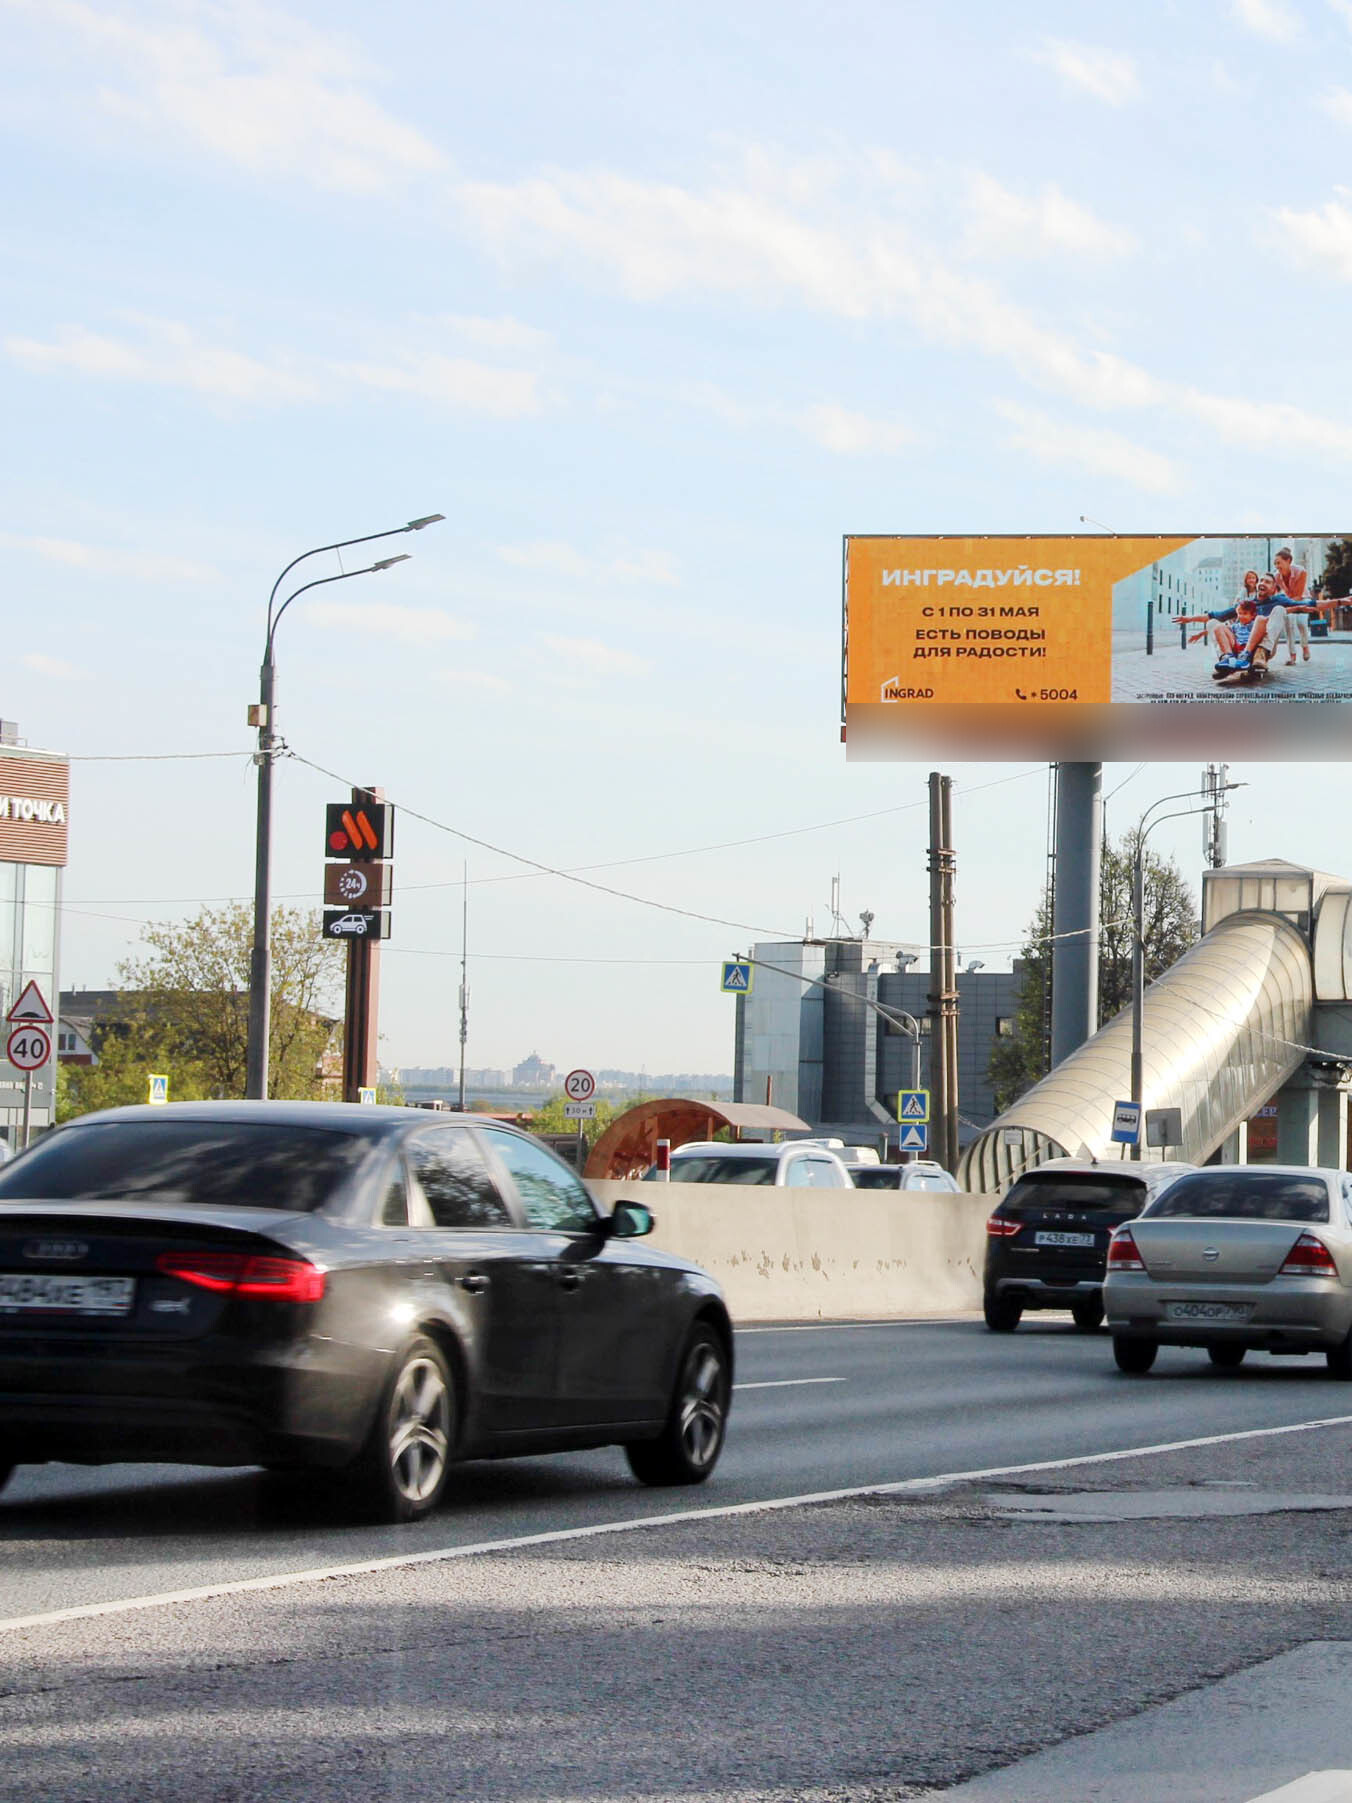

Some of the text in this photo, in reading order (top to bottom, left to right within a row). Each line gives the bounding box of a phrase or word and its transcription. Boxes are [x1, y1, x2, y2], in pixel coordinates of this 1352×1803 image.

[882, 564, 1080, 588] ИНГРАДУЙСЯ!
[921, 606, 1040, 617] С 1 ПО 31 МАЯ
[915, 629, 1046, 641] ЕСТЬ ПОВОДЫ
[913, 647, 1046, 659] ДЛЯ РАДОСТИ!
[885, 688, 934, 699] INGRAD
[10, 798, 65, 823] ТОЧКА
[13, 1038, 44, 1059] 40
[571, 1077, 590, 1092] 20
